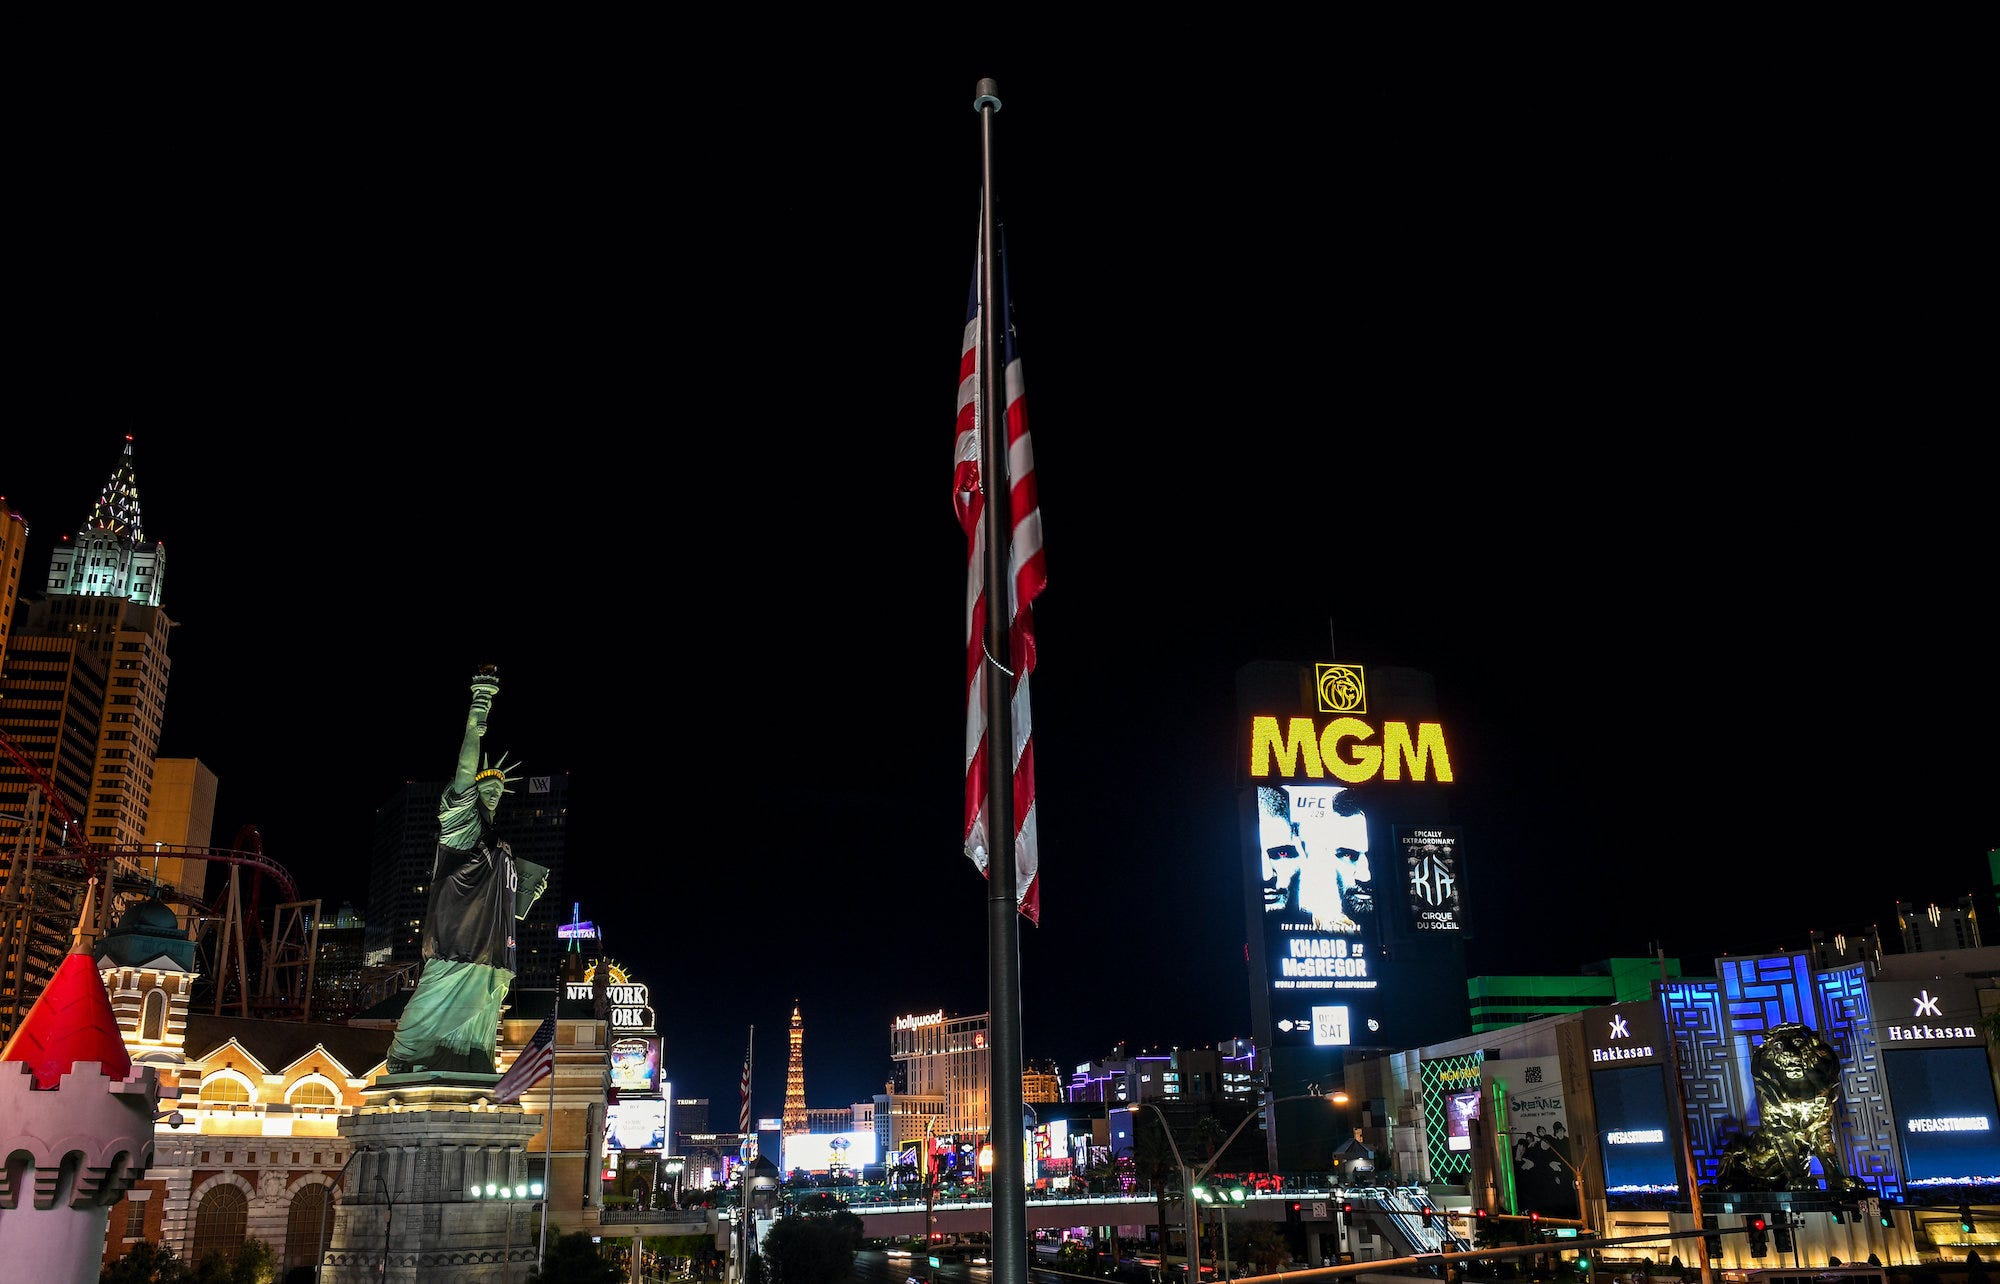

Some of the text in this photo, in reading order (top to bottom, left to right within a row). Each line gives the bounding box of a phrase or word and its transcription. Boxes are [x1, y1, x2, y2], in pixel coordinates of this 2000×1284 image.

[1251, 716, 1453, 783] MGM
[1297, 797, 1326, 809] UFC
[1421, 912, 1453, 922] CIRQUE
[1417, 922, 1459, 930] DU SOLEIL
[1289, 939, 1347, 958] KHABIB
[1282, 958, 1367, 977] McGREGOR
[606, 986, 645, 1005] YORK
[611, 1008, 644, 1026] ORK
[896, 1008, 943, 1032] hollywood
[1320, 1023, 1342, 1038] SAT
[1887, 1024, 1977, 1041] Hakkasan
[1592, 1046, 1654, 1063] Hakkasan
